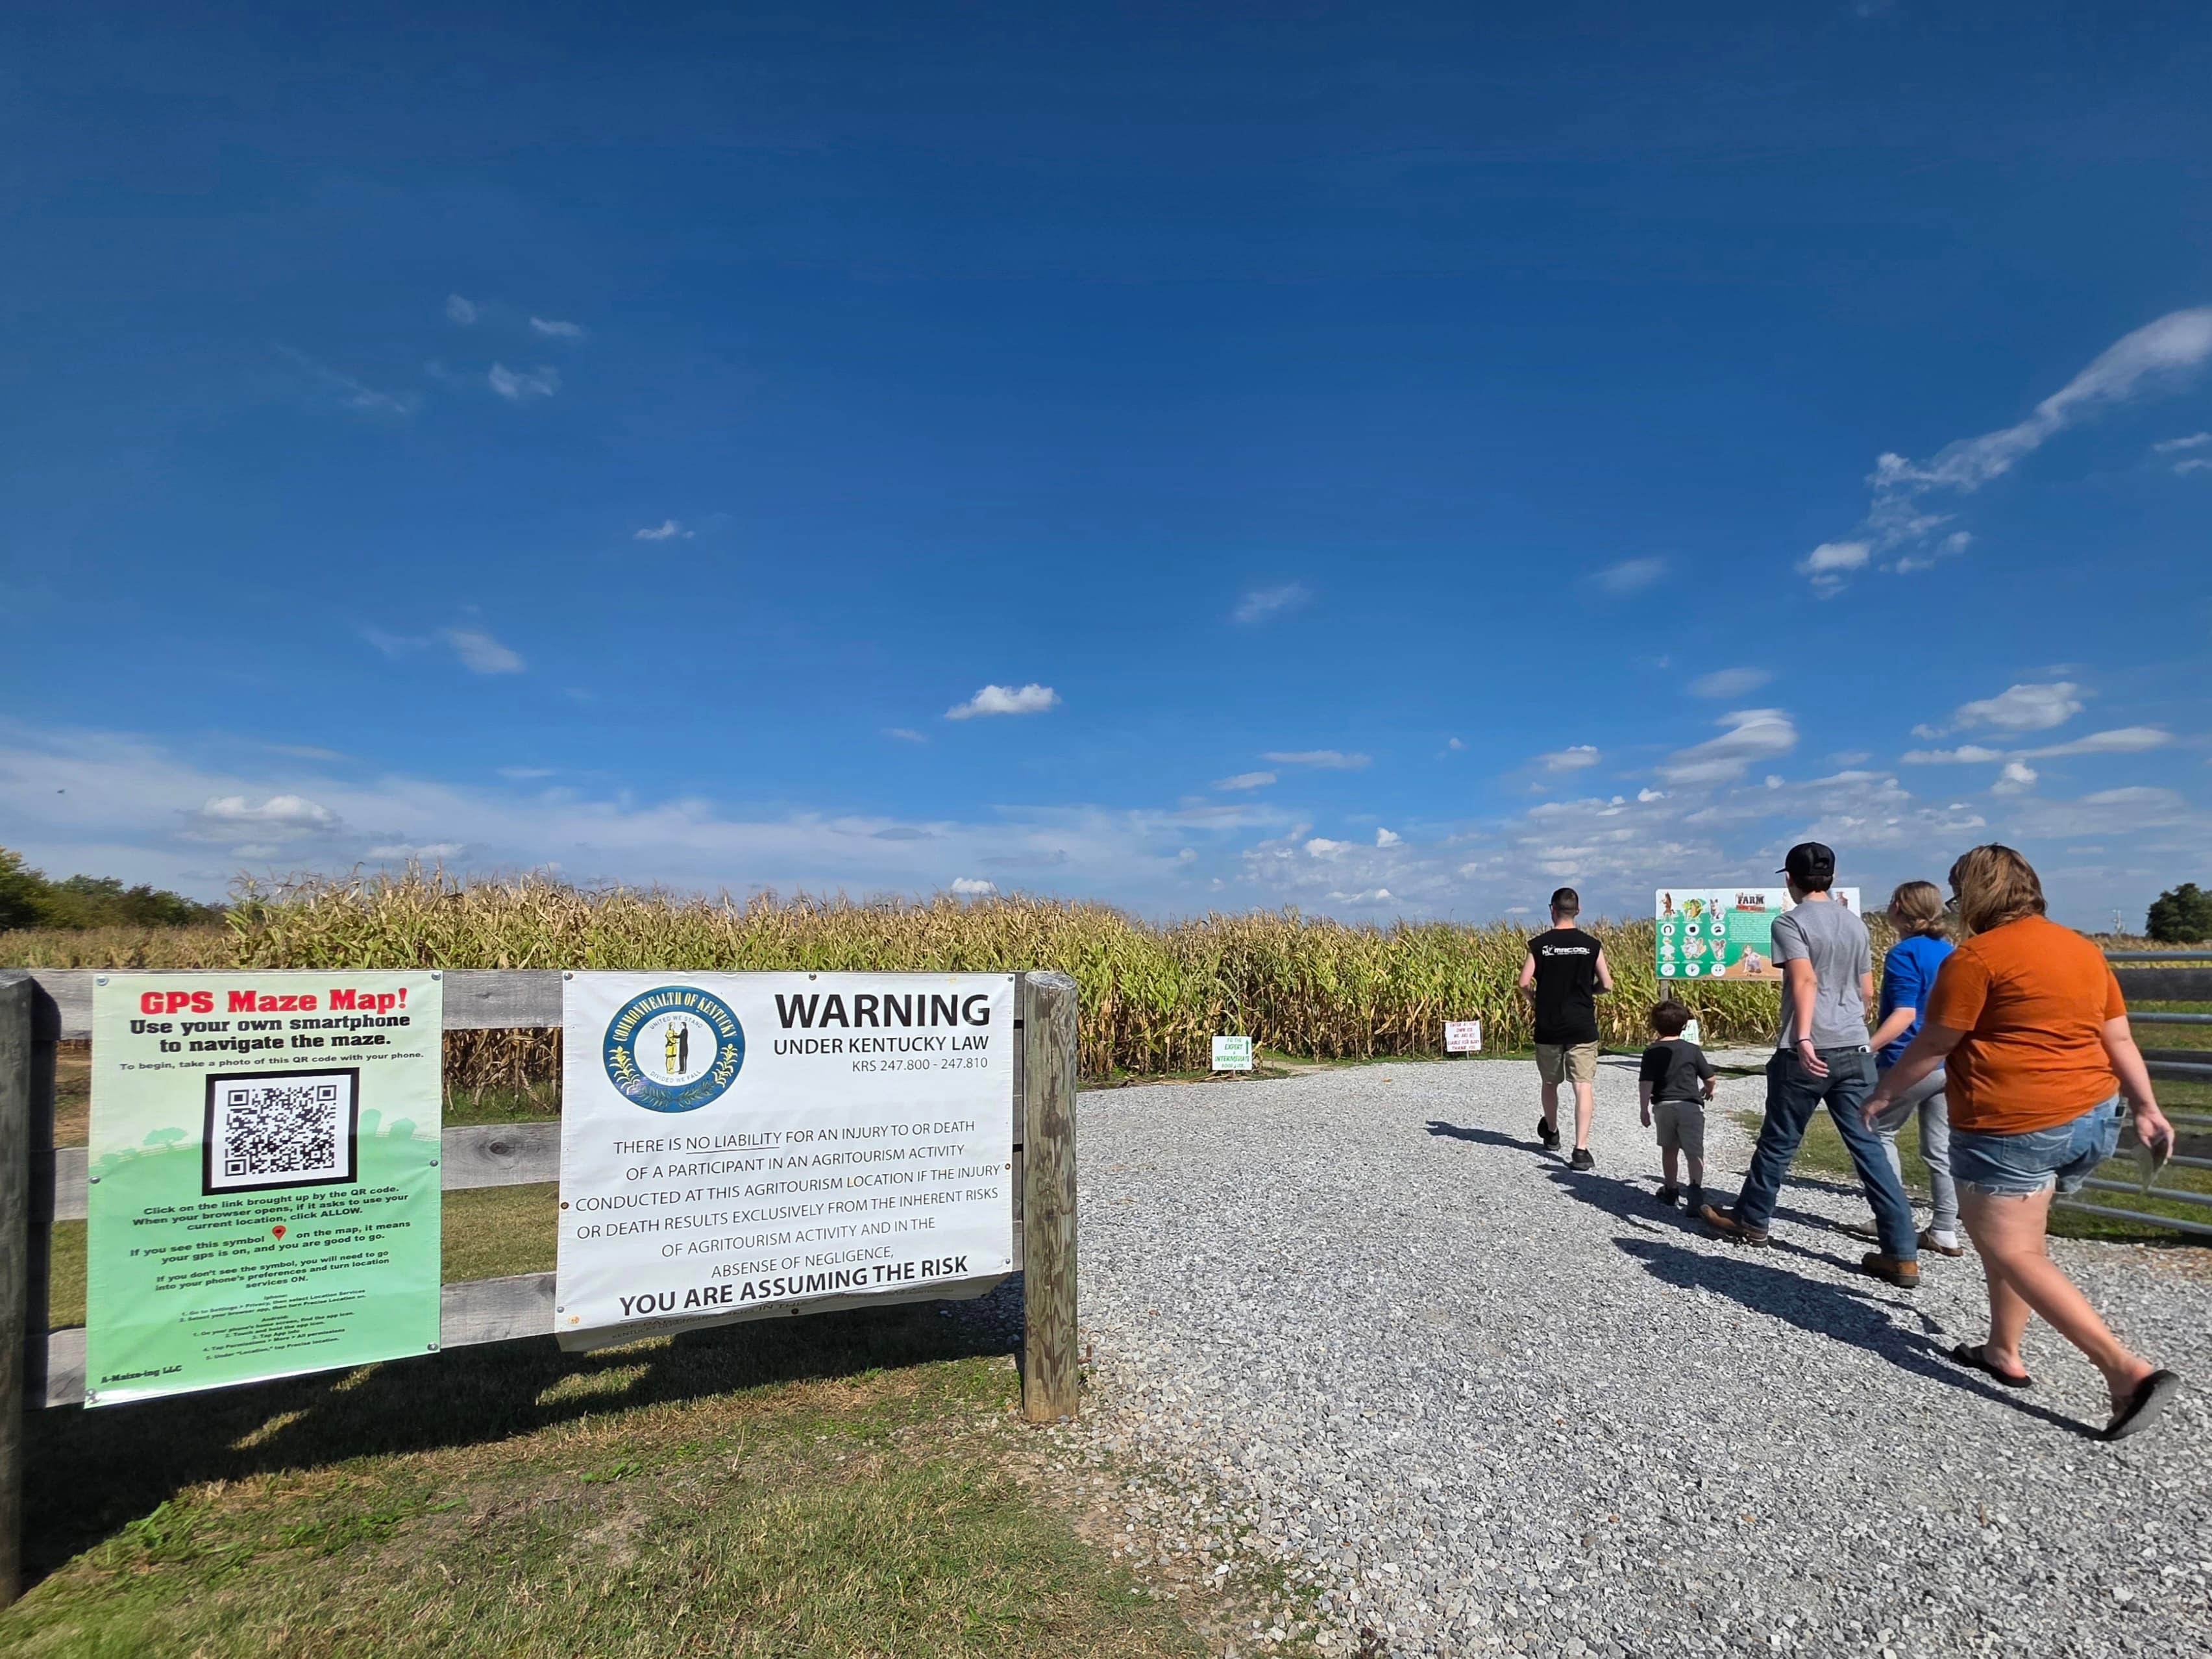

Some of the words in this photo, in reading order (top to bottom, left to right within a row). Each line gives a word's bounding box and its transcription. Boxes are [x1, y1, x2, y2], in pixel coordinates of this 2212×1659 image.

[1738, 896, 1765, 904] FARM
[141, 991, 214, 1014] GPS
[228, 990, 317, 1013] Maze
[330, 988, 407, 1014] Map!
[775, 994, 990, 1028] WARNING
[130, 1019, 172, 1034] Use
[180, 1021, 230, 1037] your
[238, 1019, 282, 1031] own
[290, 1014, 410, 1031] smartphone
[613, 992, 682, 1042] COMMONWEALTH
[684, 992, 699, 1007] OF
[697, 997, 737, 1038] KENTUCKY
[650, 1016, 671, 1029] UNITED
[684, 1016, 703, 1029] STAND
[160, 1039, 181, 1053] to
[190, 1036, 284, 1053] navigate
[291, 1034, 324, 1048] the
[331, 1035, 391, 1046] maze.
[774, 1038, 842, 1055] UNDER
[850, 1037, 946, 1053] KENTUCKY
[952, 1036, 989, 1051] LAW
[219, 1059, 251, 1068] photo
[852, 1059, 876, 1072] KRS
[880, 1059, 929, 1071] 247.800
[941, 1057, 988, 1070] 247.810
[613, 1139, 664, 1154] THERE
[669, 1138, 681, 1151] IS
[687, 1137, 710, 1149] NO
[715, 1132, 781, 1148] LIABILITY
[787, 1130, 813, 1144] FOR
[818, 1129, 837, 1141] AN
[842, 1125, 888, 1140] INJURY
[891, 1124, 908, 1137] TO
[913, 1123, 929, 1135] OR
[934, 1121, 974, 1134] DEATH
[626, 1166, 648, 1181] OF
[653, 1166, 663, 1178] A
[669, 1159, 765, 1177] PARTICIPANT
[769, 1157, 782, 1170] IN
[787, 1155, 807, 1168] AN
[812, 1149, 904, 1166] AGRITOURISM
[909, 1144, 964, 1159] ACTIVITY
[576, 1191, 680, 1212] CONDUCTED
[685, 1188, 704, 1202] AT
[707, 1185, 739, 1200] THIS
[744, 1177, 842, 1197] AGRITOURISM
[847, 1172, 913, 1188] LOCATION
[918, 1170, 927, 1182] IF
[930, 1168, 954, 1180] THE
[958, 1164, 1000, 1179] INJURY
[144, 1207, 175, 1215] Click
[247, 1195, 291, 1205] brought
[296, 1193, 309, 1202] up
[172, 1214, 199, 1224] your
[203, 1209, 251, 1220] browser
[254, 1207, 293, 1216] opens,
[385, 1195, 409, 1203] your
[578, 1225, 600, 1240] OR
[607, 1219, 659, 1236] DEATH
[665, 1212, 728, 1230] RESULTS
[733, 1203, 824, 1223] EXCLUSIVELY
[829, 1199, 867, 1214] FROM
[870, 1196, 896, 1210] THE
[900, 1190, 962, 1207] INHERENT
[966, 1187, 998, 1201] RISKS
[335, 1226, 362, 1236] map,
[376, 1221, 411, 1230] means
[662, 1243, 683, 1257] OF
[688, 1232, 791, 1255] AGRITOURISM
[795, 1225, 857, 1243] ACTIVITY
[861, 1222, 891, 1236] AND
[895, 1220, 907, 1233] IN
[911, 1217, 935, 1230] THE
[144, 1247, 166, 1257] you
[196, 1241, 219, 1249] this
[223, 1236, 265, 1247] symbol
[162, 1255, 190, 1265] your
[193, 1252, 214, 1261] gps
[254, 1244, 275, 1253] and
[278, 1242, 299, 1251] you
[324, 1236, 351, 1246] good
[168, 1273, 187, 1283] you
[260, 1260, 297, 1272] symbol,
[301, 1259, 317, 1267] you
[179, 1281, 203, 1290] your
[248, 1269, 307, 1282] preferences
[352, 1258, 389, 1267] location
[711, 1259, 777, 1278] ABSENSE
[781, 1256, 800, 1270] OF
[805, 1246, 893, 1267] NEGLIGENCE,
[620, 1291, 675, 1316] YOU
[683, 1284, 732, 1309] ARE
[740, 1268, 867, 1301] ASSUMING
[872, 1262, 915, 1286] THE
[922, 1255, 968, 1279] RISK
[163, 1364, 182, 1374] LLC
